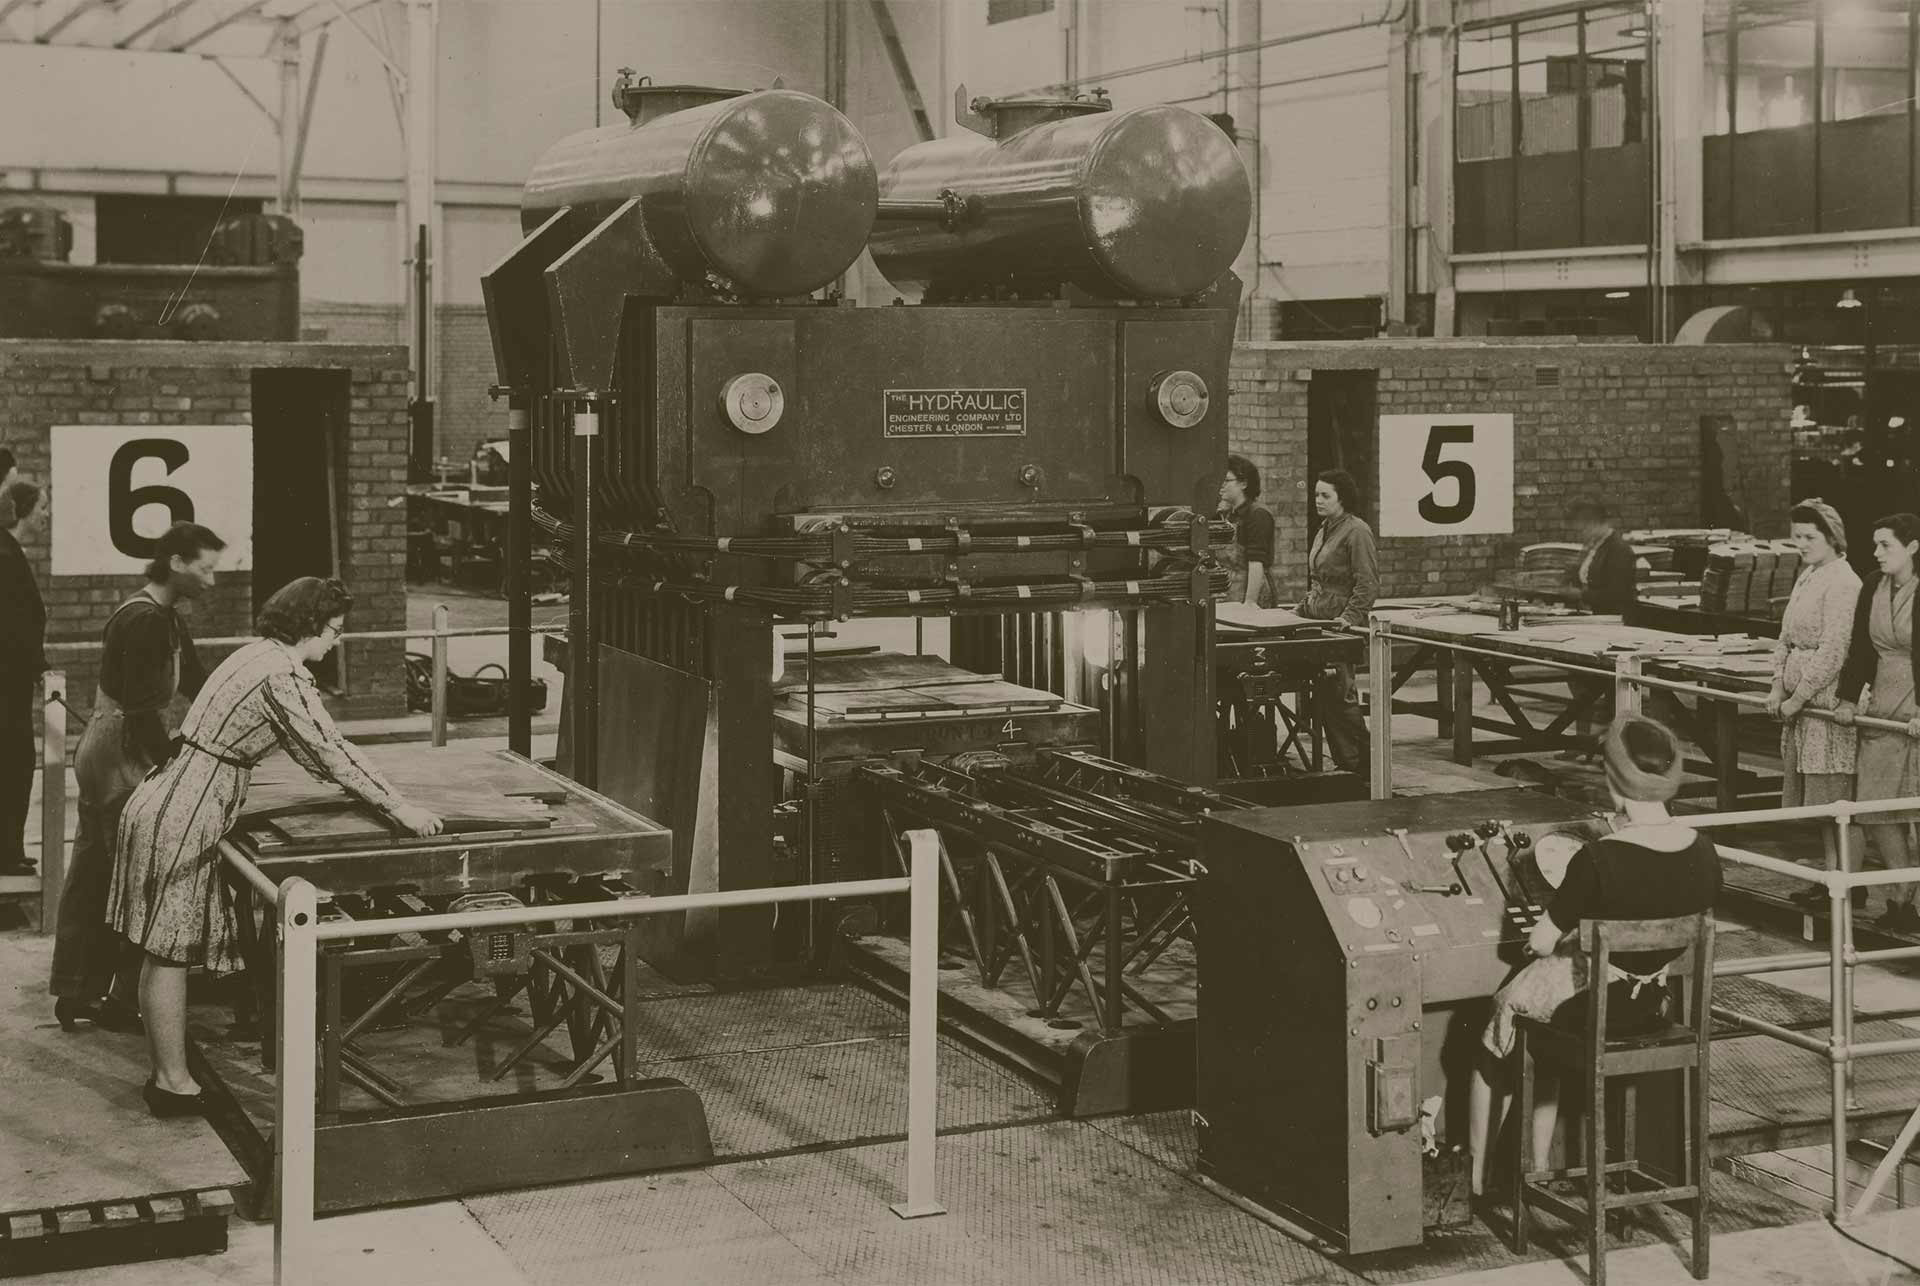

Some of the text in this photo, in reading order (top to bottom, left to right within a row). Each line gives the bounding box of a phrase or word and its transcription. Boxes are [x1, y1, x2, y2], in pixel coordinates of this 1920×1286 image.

[891, 394, 1020, 411] THE HYDRAULIC
[889, 413, 1022, 423] ENGINEERING COMPANY LTD
[889, 424, 933, 433] CHESTER
[936, 424, 943, 432] &
[945, 423, 983, 433] LONDON
[1418, 425, 1475, 524] 5
[108, 438, 195, 560] 6
[1000, 718, 1023, 740] 4
[458, 850, 474, 889] 1
